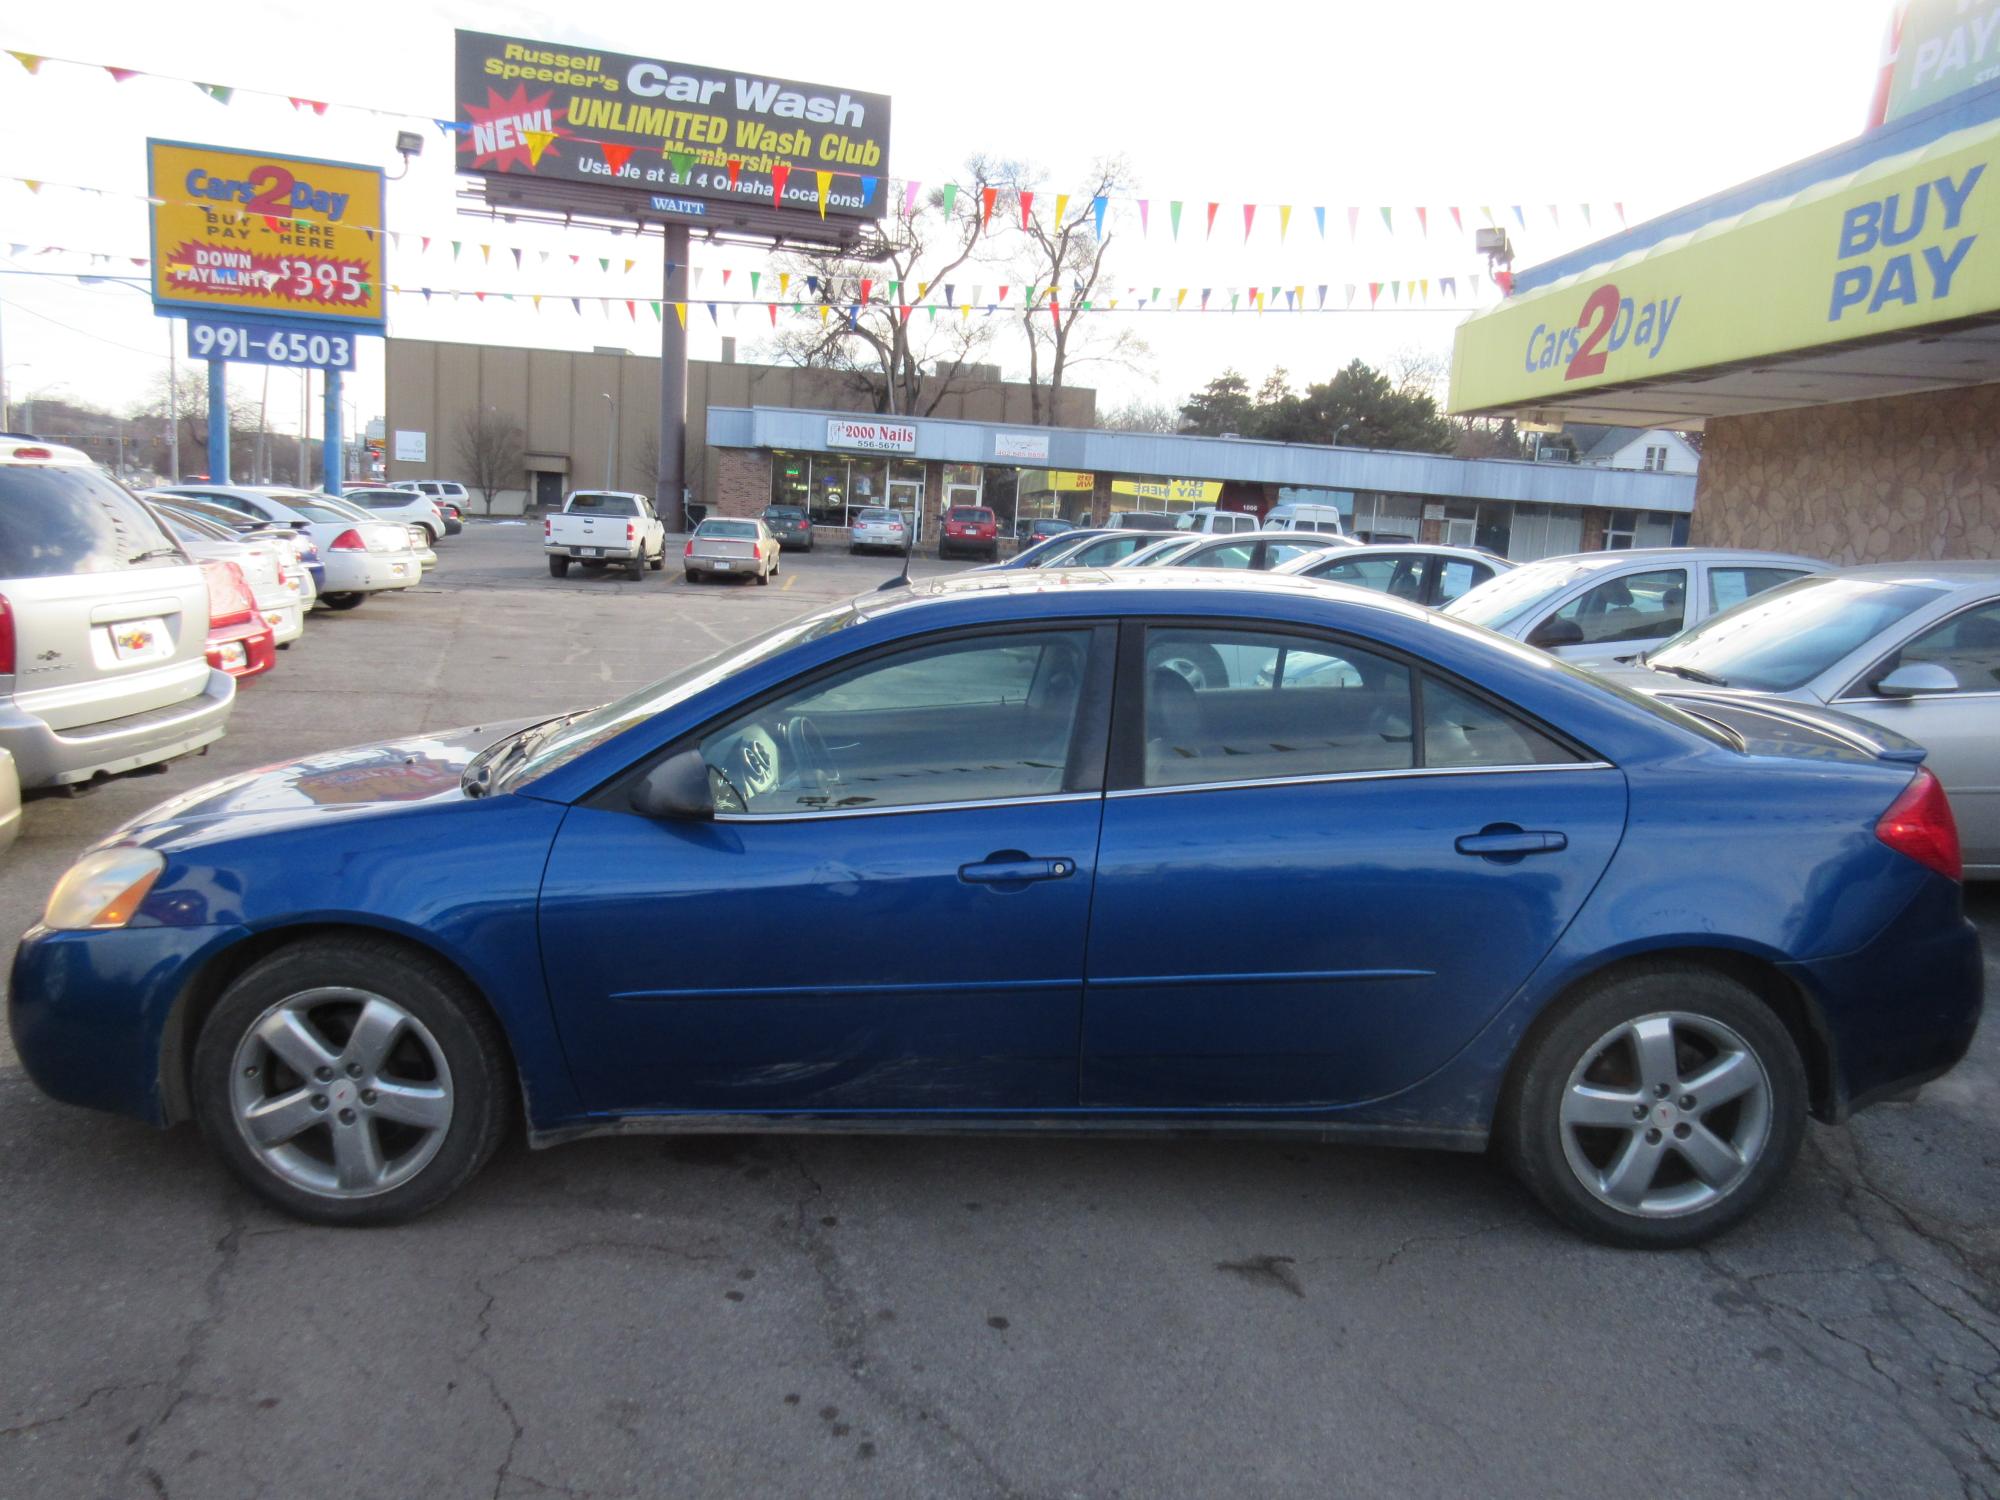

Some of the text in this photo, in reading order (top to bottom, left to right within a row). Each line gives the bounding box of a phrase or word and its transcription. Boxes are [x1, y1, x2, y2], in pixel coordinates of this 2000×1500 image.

[485, 58, 619, 91] Speeder's
[505, 44, 601, 71] Russell
[627, 63, 865, 127] Car Wash
[473, 109, 552, 155] NEW!
[568, 97, 880, 167] UNLIMITED Wash Club
[646, 169, 665, 182] at
[670, 171, 692, 186] al
[697, 173, 708, 187] 4
[780, 183, 865, 208] Locaions!
[653, 198, 704, 214] WAITT
[206, 213, 250, 227] BUY
[1838, 162, 1988, 260] BUY
[206, 226, 335, 249] PAY HERE
[196, 250, 251, 270] DOWN
[1828, 234, 1978, 322] PAY
[279, 259, 361, 301] $395
[194, 324, 350, 368] 991-6503
[846, 425, 913, 442] 2000 Nails
[857, 440, 900, 449] 556-5671
